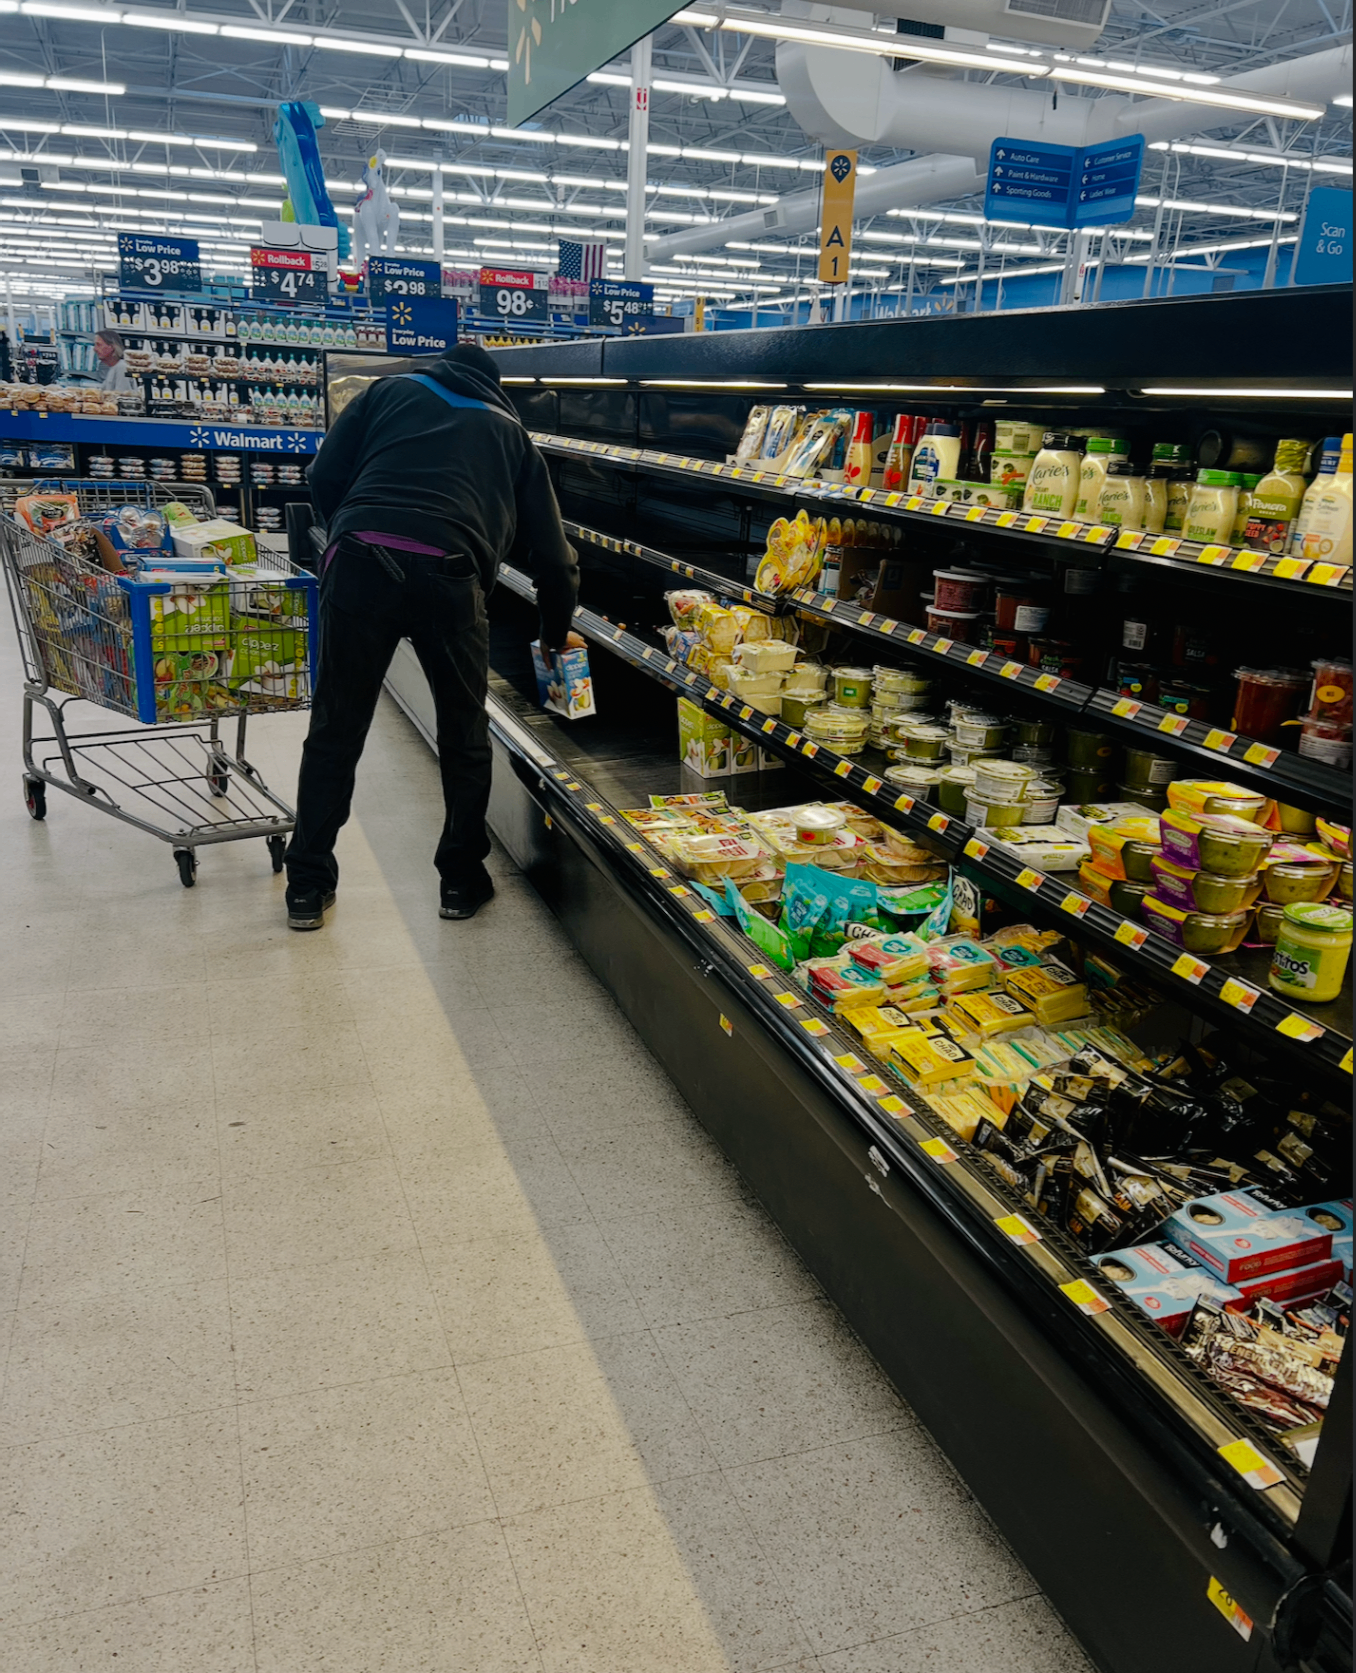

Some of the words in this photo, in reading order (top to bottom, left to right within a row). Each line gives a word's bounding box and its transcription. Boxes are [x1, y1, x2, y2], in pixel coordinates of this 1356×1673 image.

[1010, 152, 1025, 162] Auto
[1026, 154, 1039, 163] Care
[1008, 169, 1024, 179] Paint
[1024, 171, 1030, 179] &
[1030, 172, 1058, 182] Hardware
[1006, 185, 1032, 197] Sporting
[1033, 188, 1052, 198] Goods
[825, 225, 845, 247] A
[1320, 222, 1345, 238] Scan
[135, 242, 156, 253] Low
[157, 245, 181, 255] Price
[1316, 239, 1325, 253] &
[1327, 241, 1343, 255] Go
[267, 254, 306, 266] Rollback
[831, 256, 838, 276] 1
[384, 265, 403, 275] Low
[403, 267, 425, 277] Price
[495, 274, 529, 285] Rollback
[604, 286, 620, 296] Low
[620, 288, 640, 298] Price
[392, 333, 416, 346] Low
[417, 335, 446, 348] Price
[213, 431, 284, 449] Walmart
[1252, 498, 1288, 512] Panera
[852, 926, 878, 939] CH
[1046, 966, 1070, 981] CHAO
[995, 996, 1017, 1012] CHAO
[882, 1008, 903, 1024] CHAO
[934, 1039, 957, 1059] CHAO
[1251, 1189, 1287, 1210] Tofurky
[1164, 1242, 1201, 1267] Tofurky
